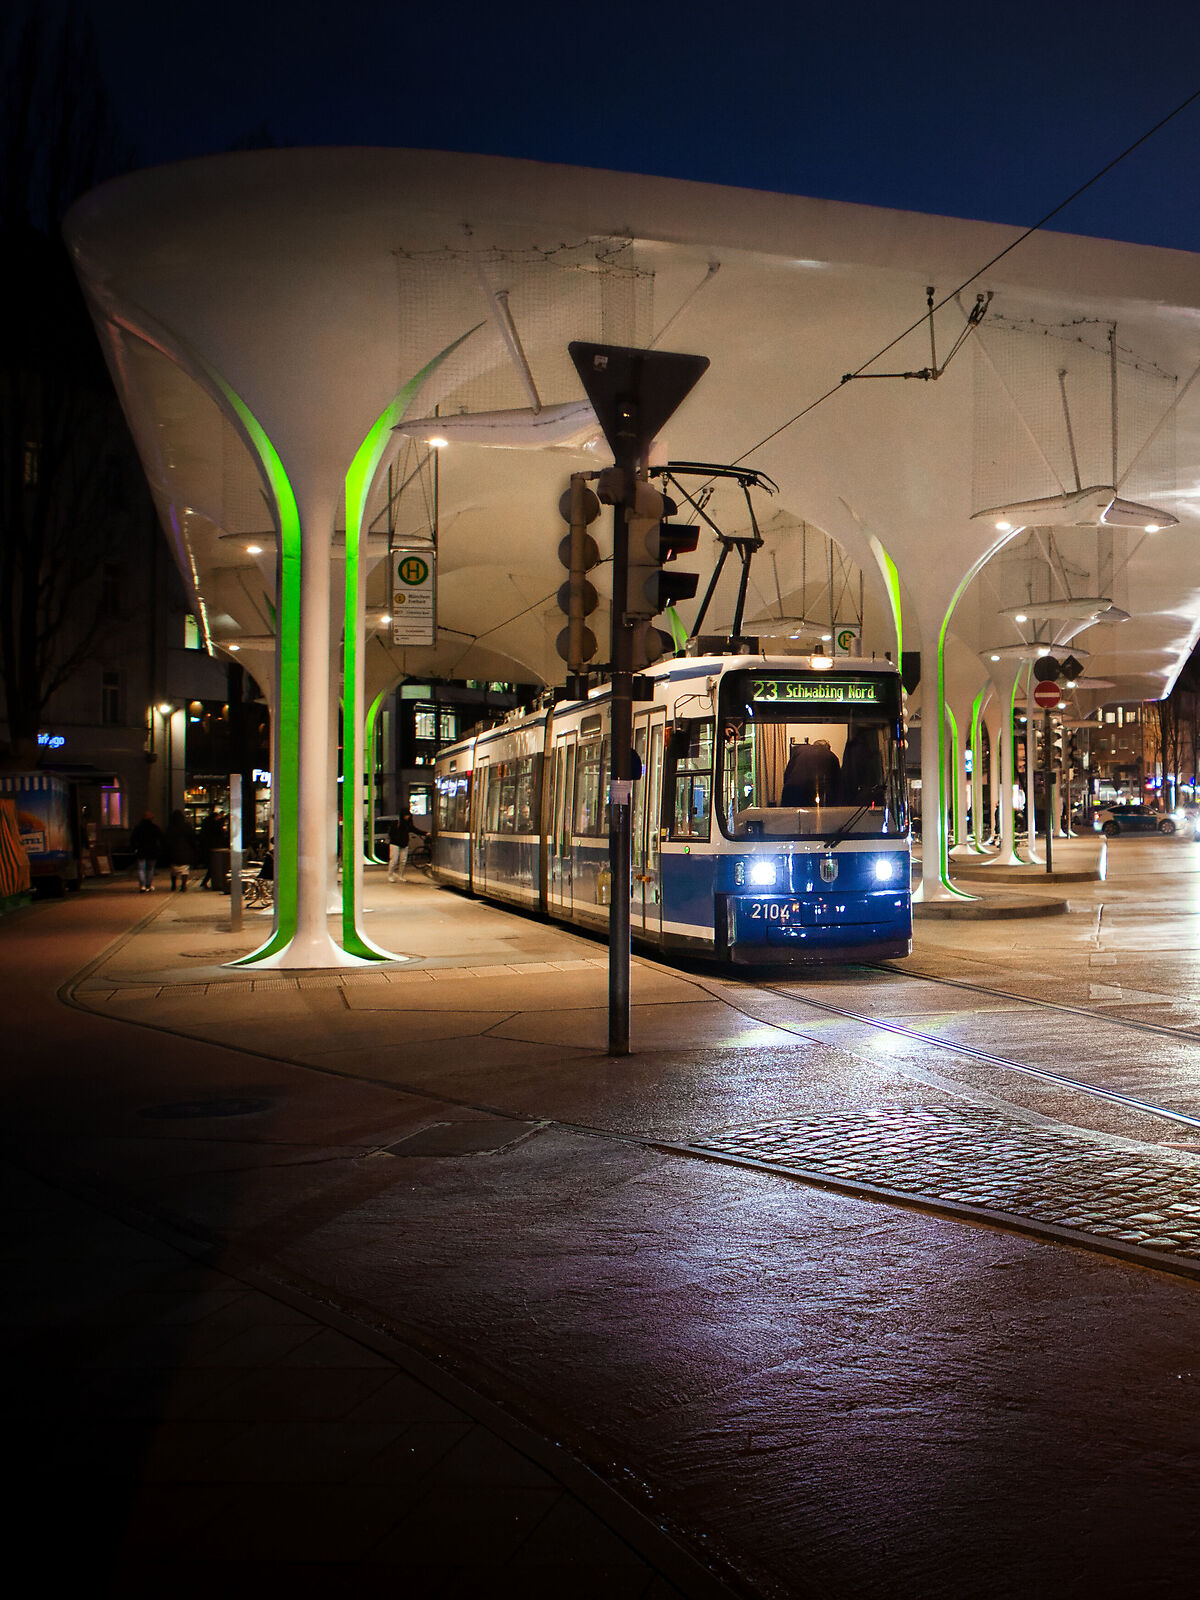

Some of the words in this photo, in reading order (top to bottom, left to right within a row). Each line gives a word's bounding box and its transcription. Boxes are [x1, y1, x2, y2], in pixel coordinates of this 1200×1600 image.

[406, 562, 420, 579] H
[753, 682, 778, 701] 23
[785, 683, 844, 701] Schwabing
[751, 903, 790, 920] 2104
